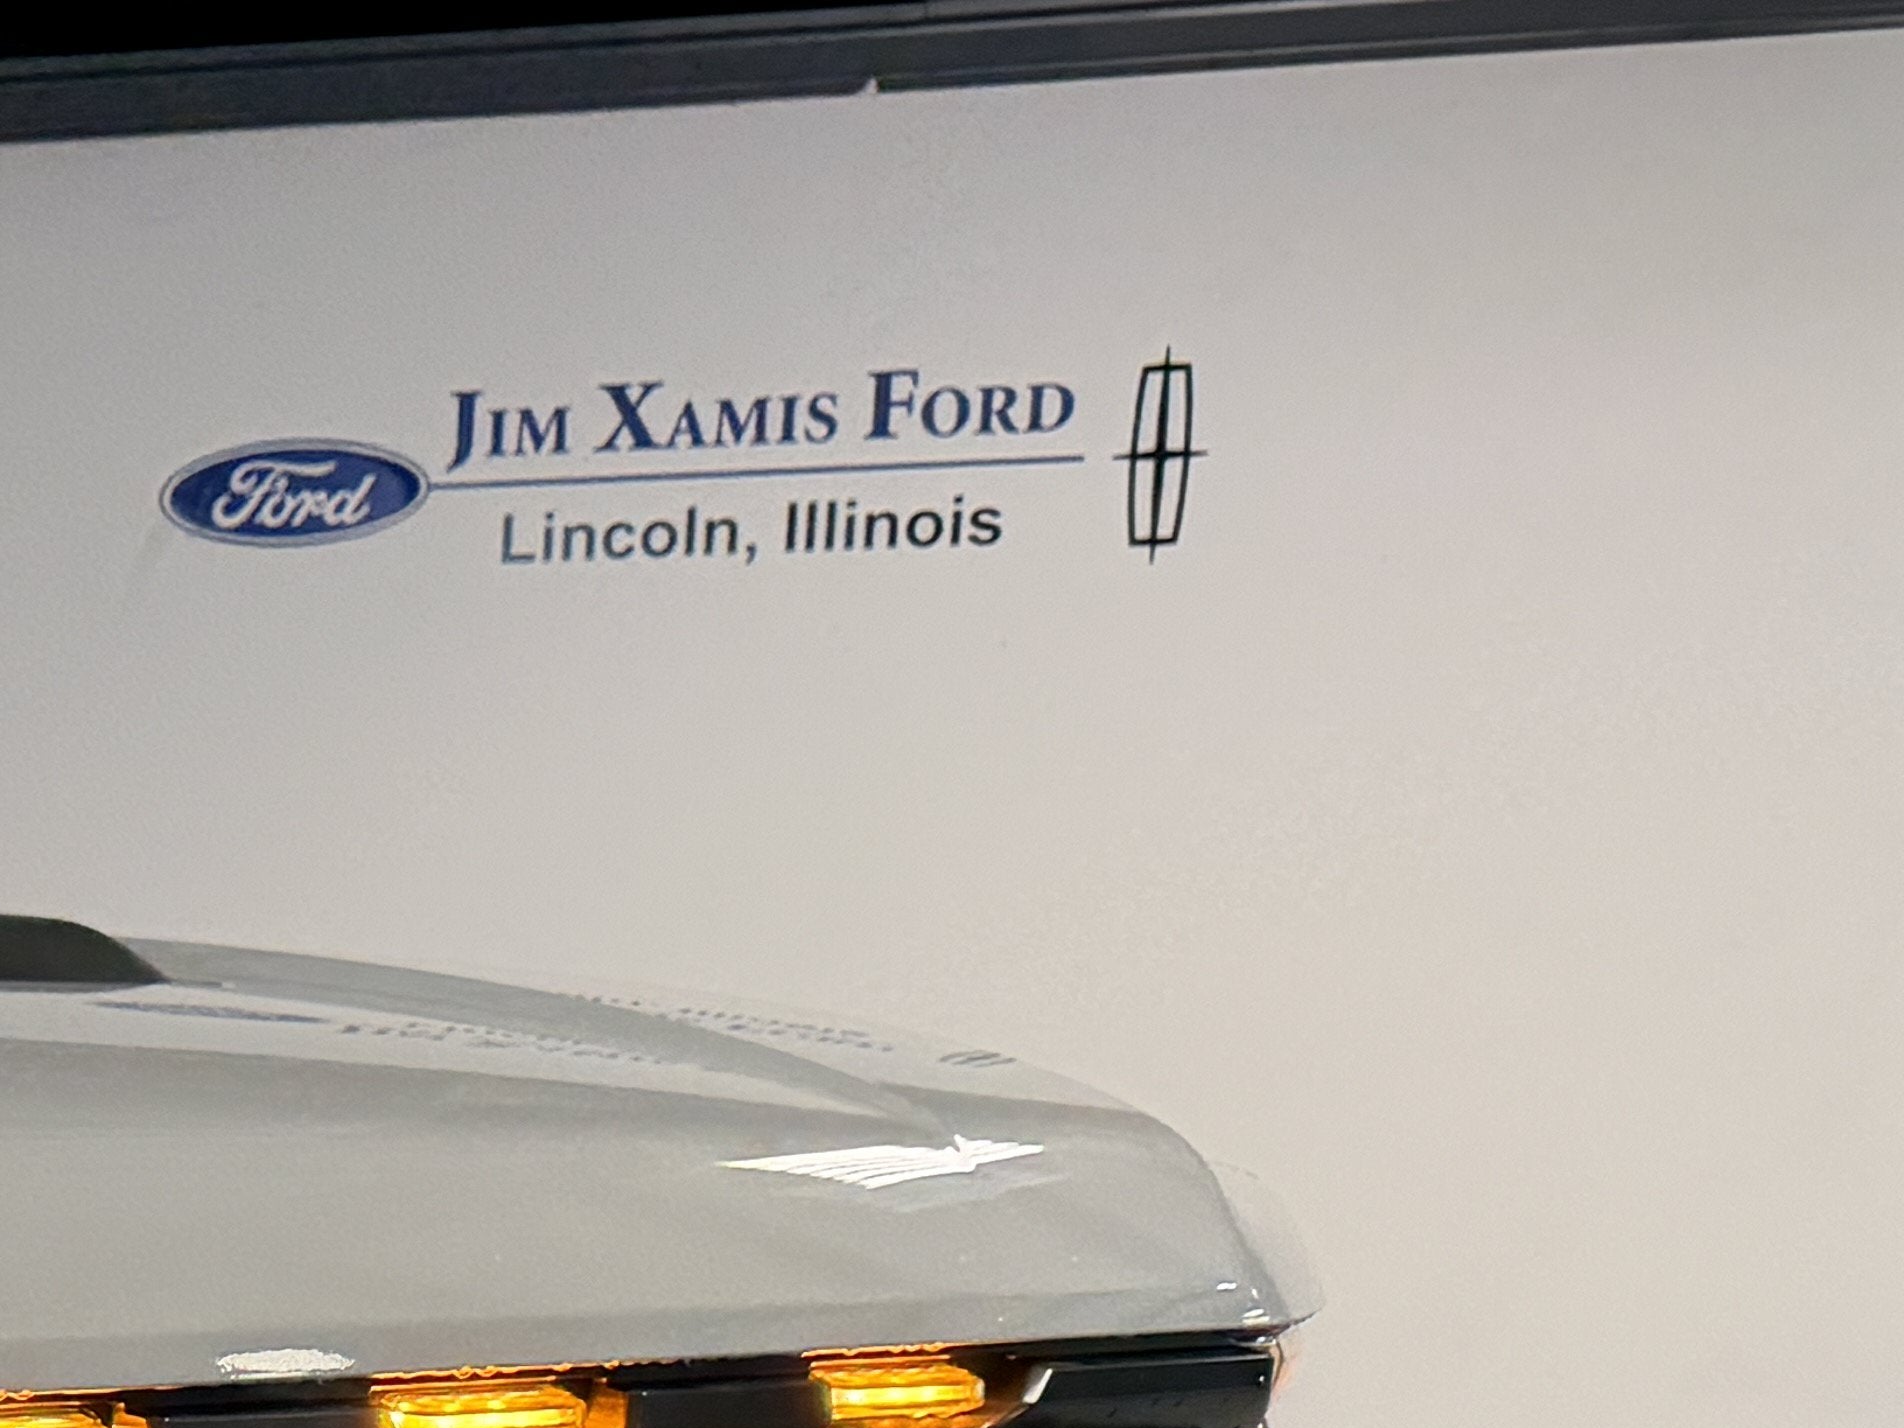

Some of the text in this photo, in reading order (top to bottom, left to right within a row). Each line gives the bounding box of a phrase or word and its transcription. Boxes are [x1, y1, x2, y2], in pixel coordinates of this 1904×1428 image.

[445, 367, 1076, 471] JIM XAMIS FORD
[210, 458, 378, 529] Ford
[499, 492, 1004, 565] Lincoln, Illinois
